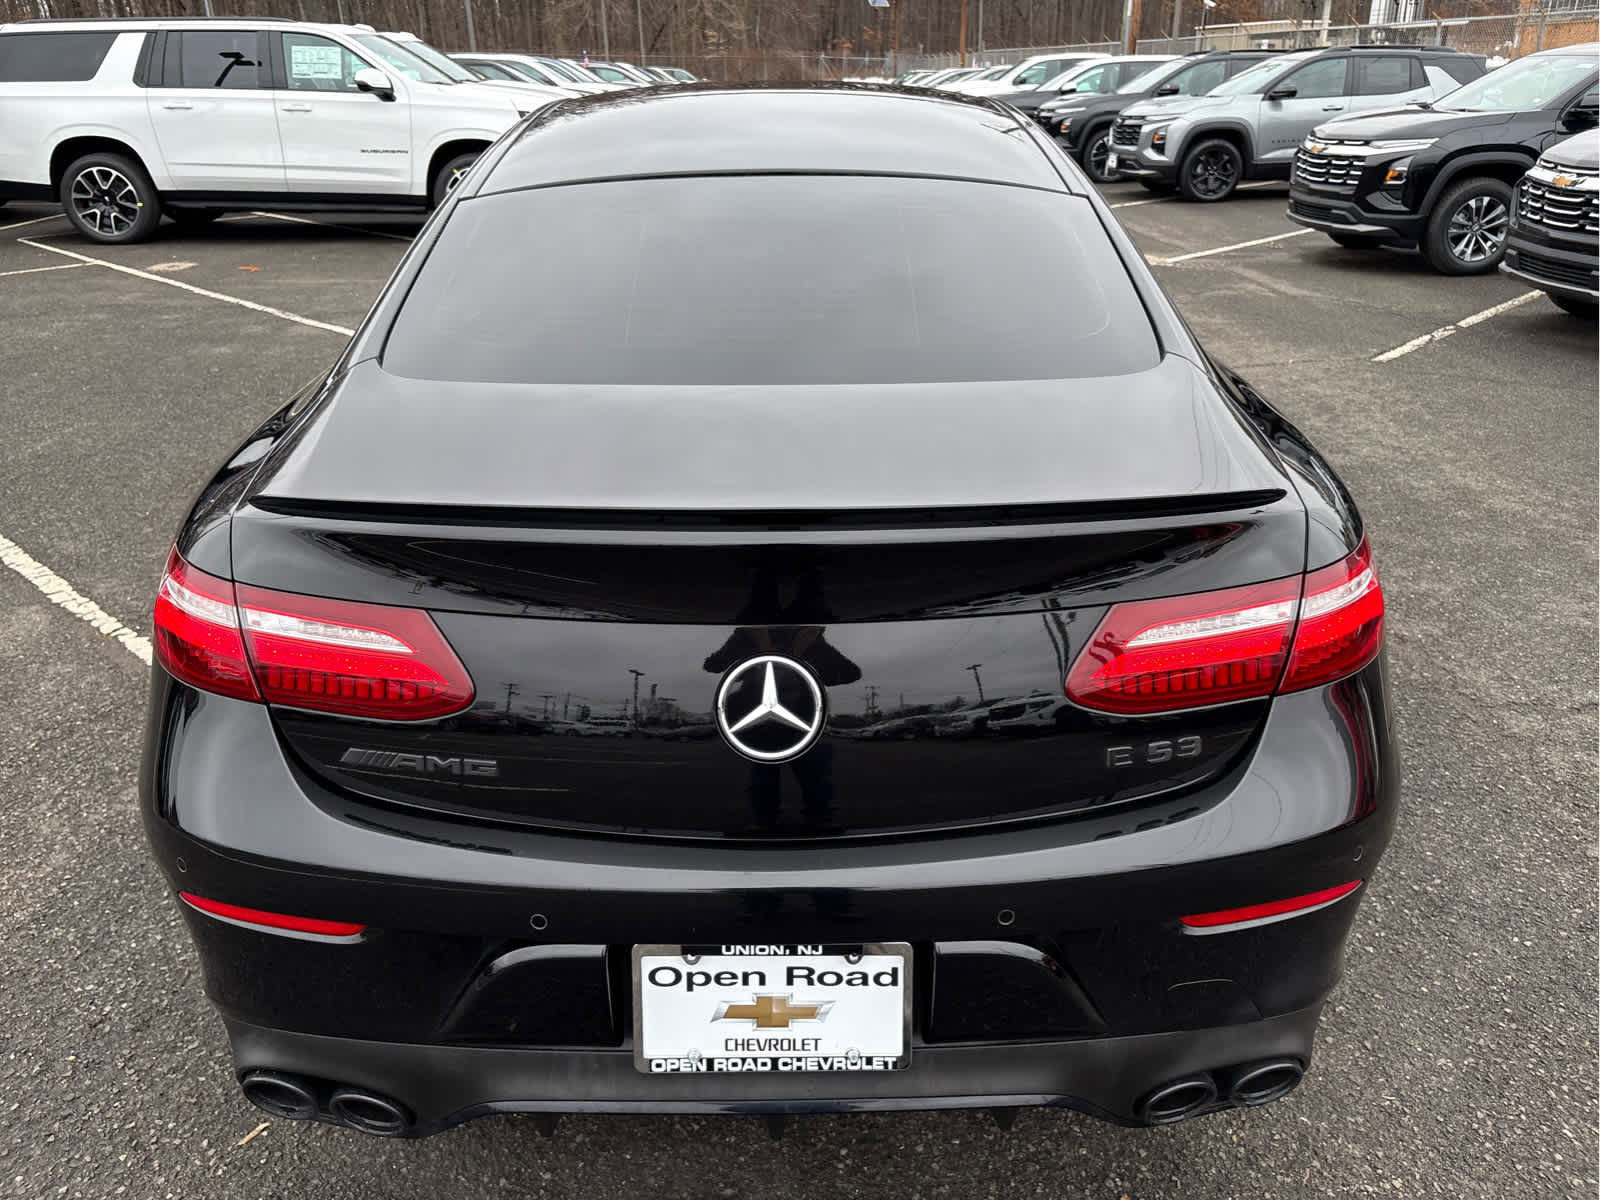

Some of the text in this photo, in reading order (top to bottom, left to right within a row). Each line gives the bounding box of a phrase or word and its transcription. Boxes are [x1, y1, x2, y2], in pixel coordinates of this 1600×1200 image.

[1106, 736, 1202, 768] E 53
[388, 752, 499, 777] AMG
[721, 944, 823, 956] UNION, NJ
[648, 966, 899, 992] Open Road
[724, 1038, 822, 1052] CHEVROLET
[651, 1056, 897, 1073] OPEN ROAD CHEVROLET
